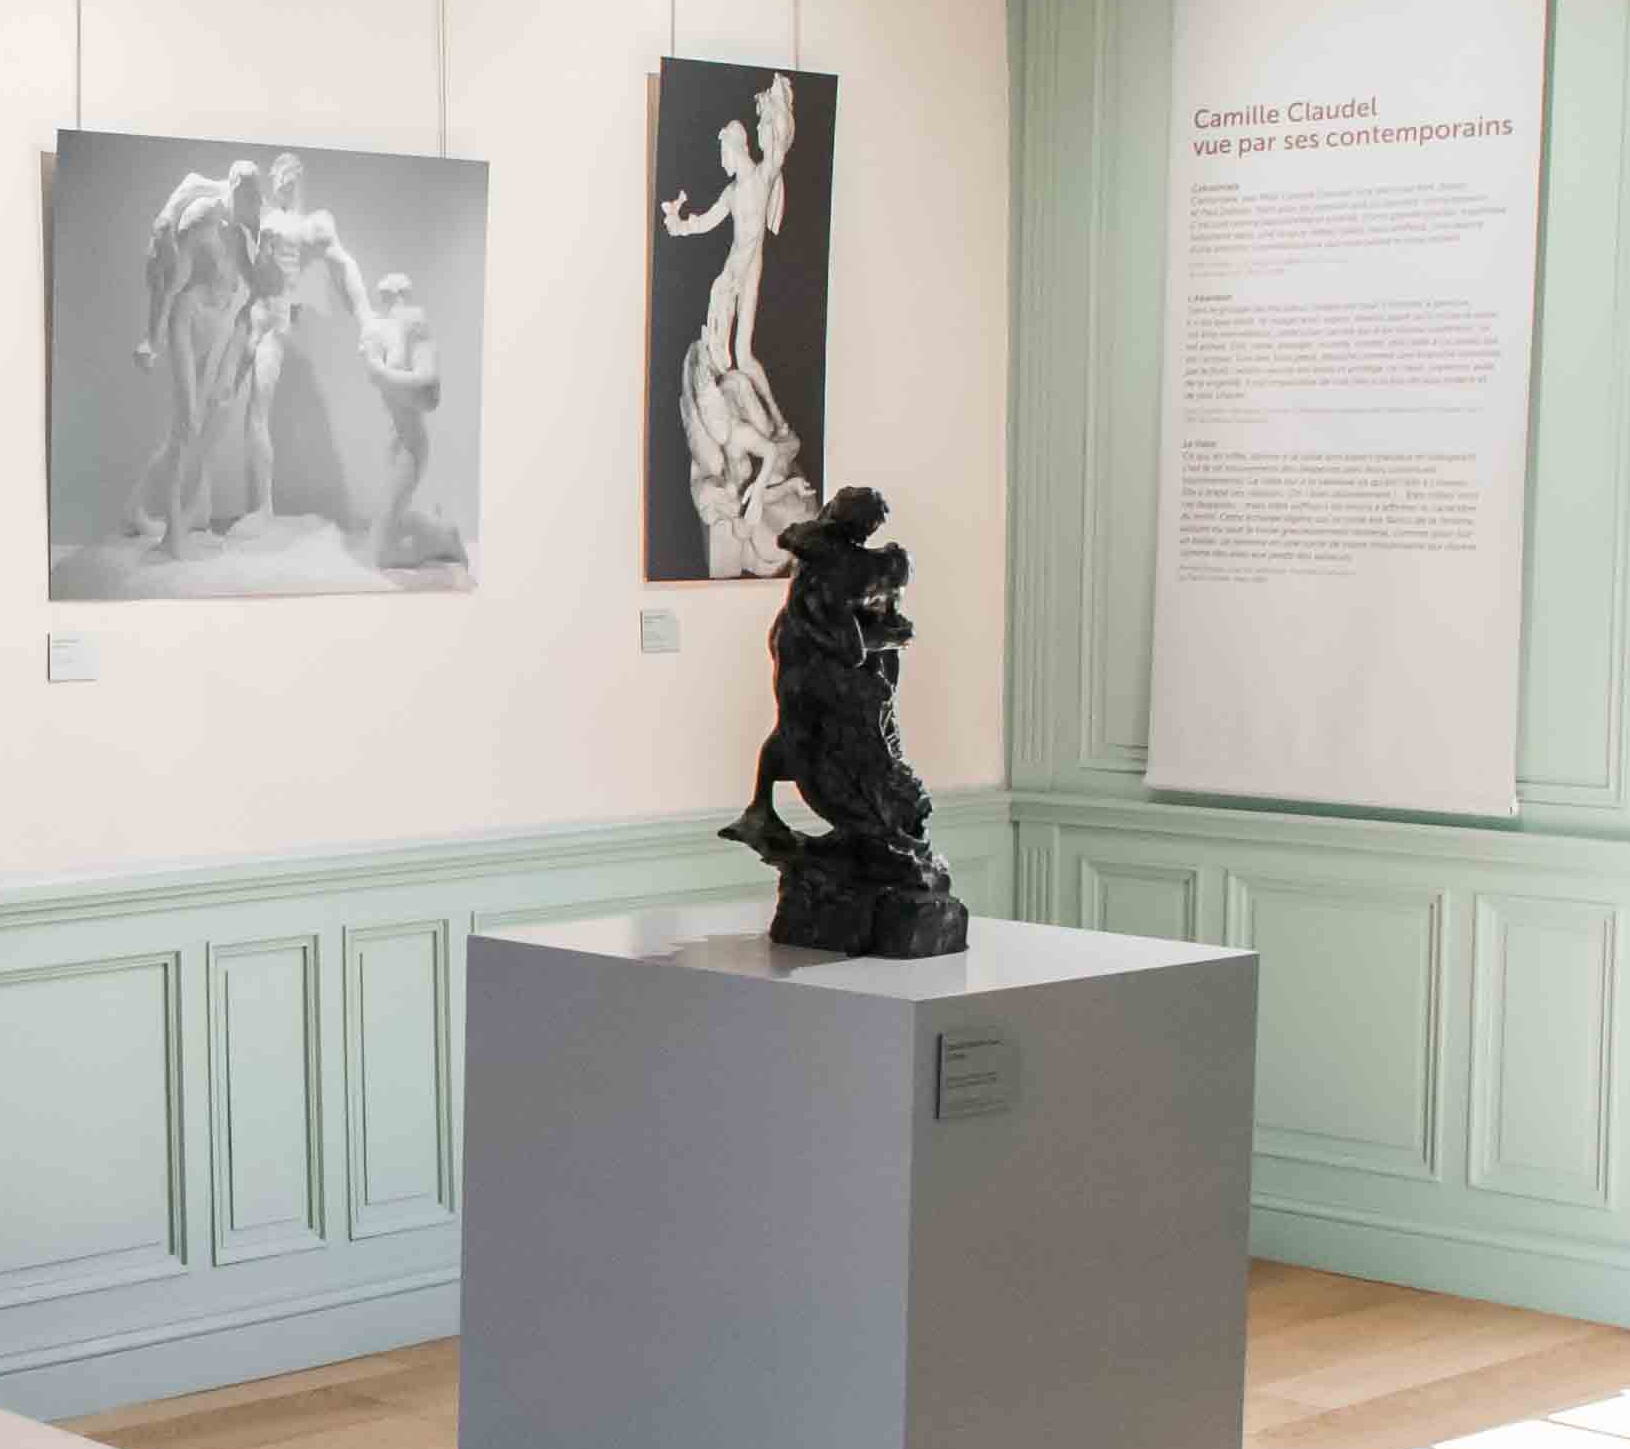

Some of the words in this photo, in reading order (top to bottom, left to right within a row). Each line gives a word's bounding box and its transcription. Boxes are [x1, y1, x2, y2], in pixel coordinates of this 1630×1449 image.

[1193, 105, 1280, 129] Camille
[1287, 96, 1378, 123] Claudel
[1192, 137, 1232, 157] vue
[1237, 134, 1277, 159] par
[1283, 131, 1320, 151] ses
[1326, 115, 1514, 147] contemporains
